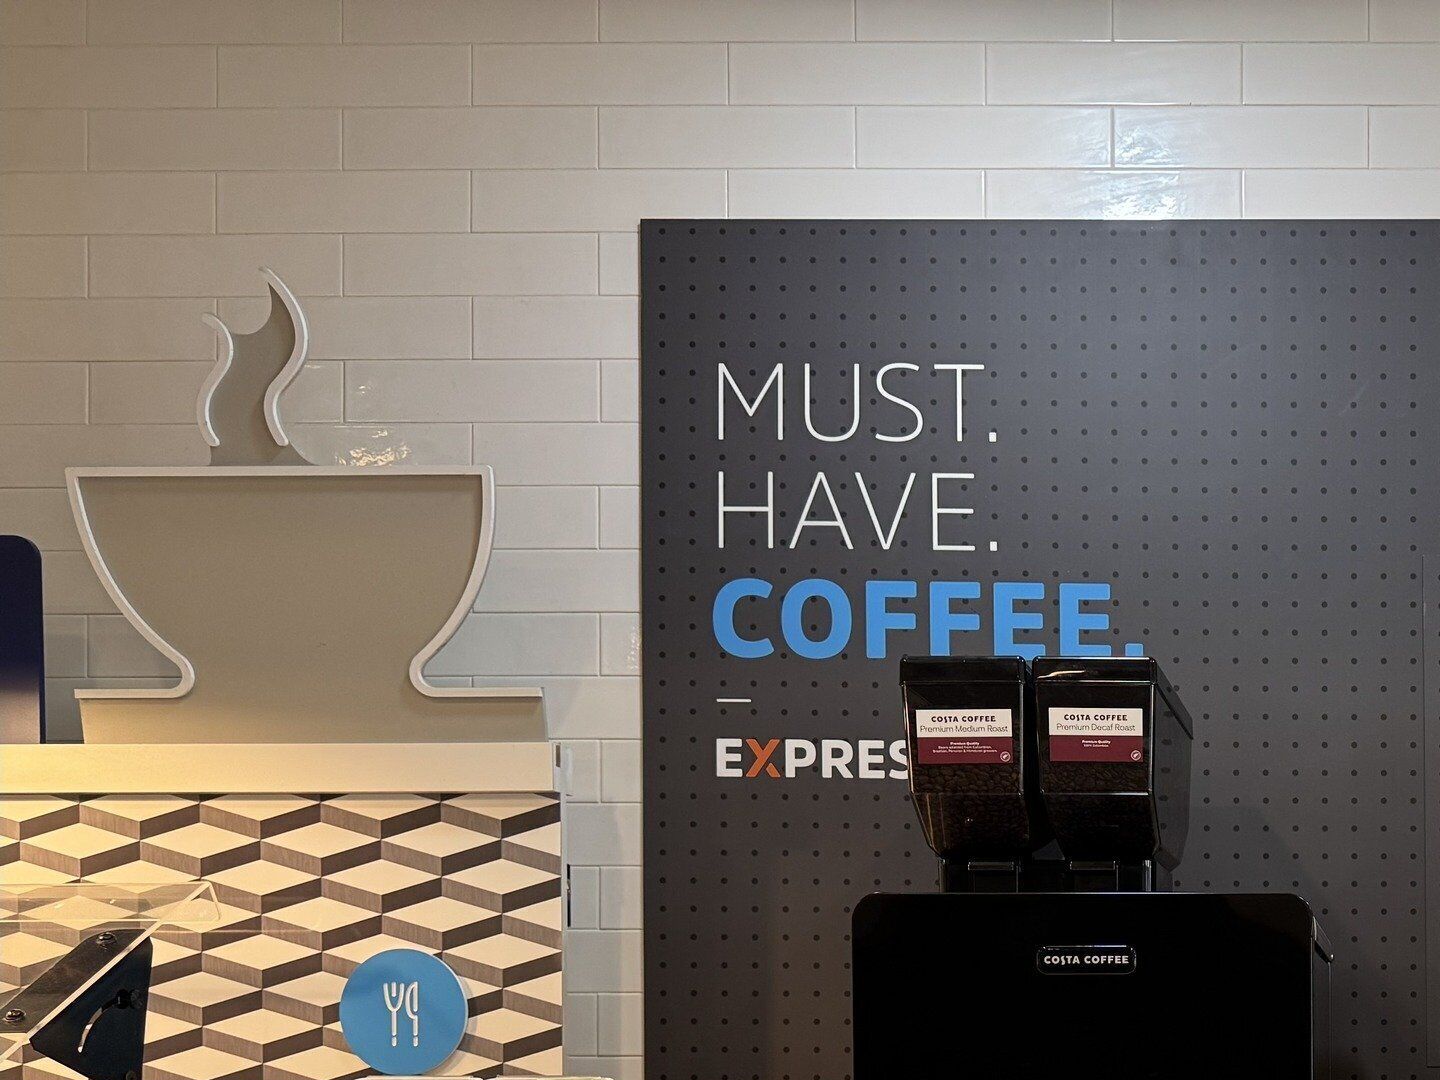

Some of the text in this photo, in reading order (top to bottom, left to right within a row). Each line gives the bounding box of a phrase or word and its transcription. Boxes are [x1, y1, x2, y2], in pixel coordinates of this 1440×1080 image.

[717, 361, 998, 443] MUST.
[717, 470, 999, 552] HAVE.
[711, 577, 1144, 660] COFFEE.
[931, 715, 959, 723] COSTA
[1063, 714, 1091, 722] COSTA
[920, 724, 1009, 733] Premium Medium Roast
[1056, 722, 1136, 731] Premium Decaf Roast
[1043, 955, 1130, 966] COSTA COFFEE
